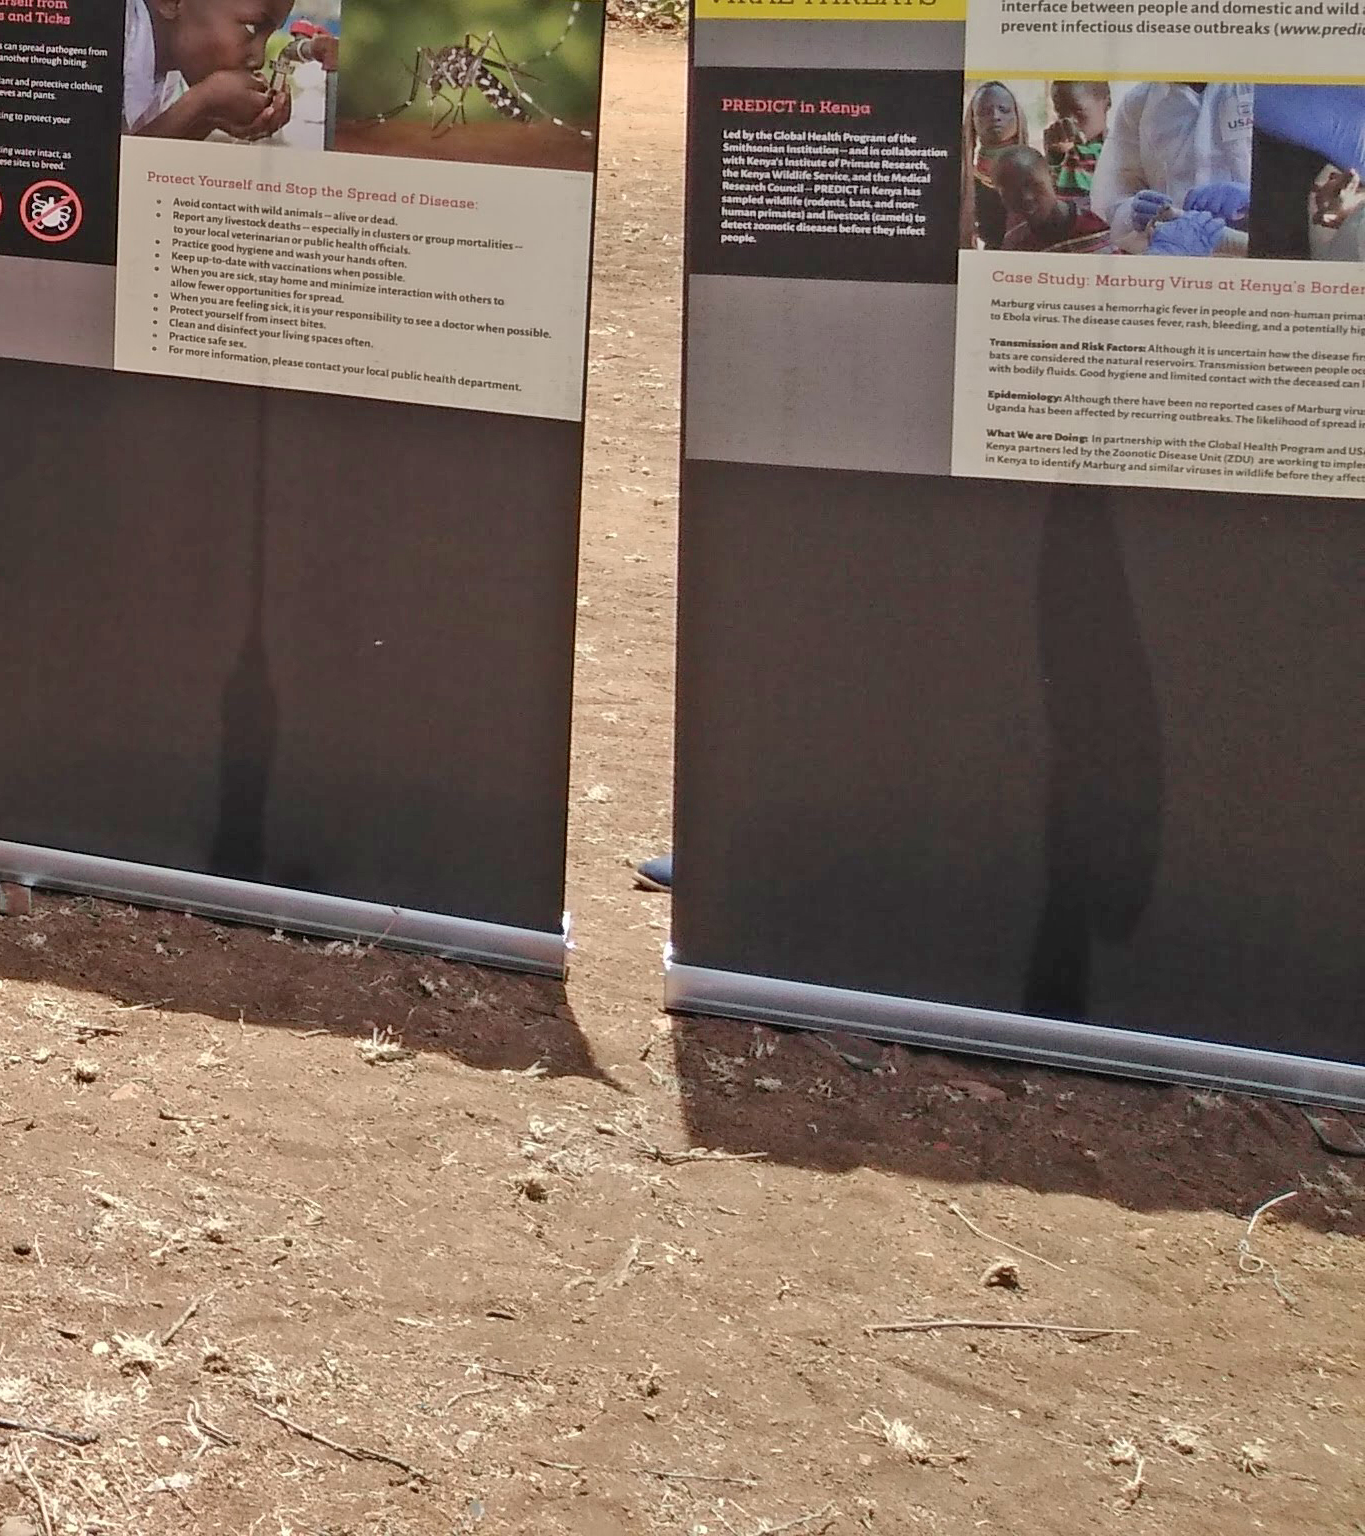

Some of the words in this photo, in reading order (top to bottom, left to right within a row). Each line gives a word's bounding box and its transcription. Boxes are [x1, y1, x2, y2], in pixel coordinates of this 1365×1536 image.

[7, 11, 32, 22] and
[34, 11, 71, 24] Ticks
[721, 98, 796, 112] PREDICT
[799, 101, 814, 112] in
[819, 101, 871, 116] Kenya
[723, 129, 741, 139] Led
[742, 129, 754, 141] by
[755, 130, 772, 140] the
[773, 131, 806, 140] Global
[807, 131, 841, 141] Health
[842, 132, 886, 143] Program
[887, 133, 899, 142] of
[899, 133, 917, 143] the
[147, 171, 195, 185] Protect
[197, 175, 252, 189] Yourself
[255, 182, 281, 192] and
[285, 182, 317, 198] Stop
[321, 185, 342, 197] the
[347, 187, 396, 202] Spread
[401, 192, 415, 204] of
[419, 193, 478, 208] Disease:
[172, 197, 199, 207] Avoid
[201, 202, 236, 211] contact
[237, 203, 259, 213] with
[261, 205, 282, 215] wild
[283, 208, 322, 218] animals
[332, 211, 356, 221] alive
[369, 214, 398, 225] dead.
[991, 270, 1032, 283] Case
[1037, 272, 1089, 288] Study:
[1095, 274, 1165, 290] Marburg
[1169, 276, 1212, 289] Virus
[1217, 280, 1234, 290] at
[1239, 279, 1305, 295] Kenya's
